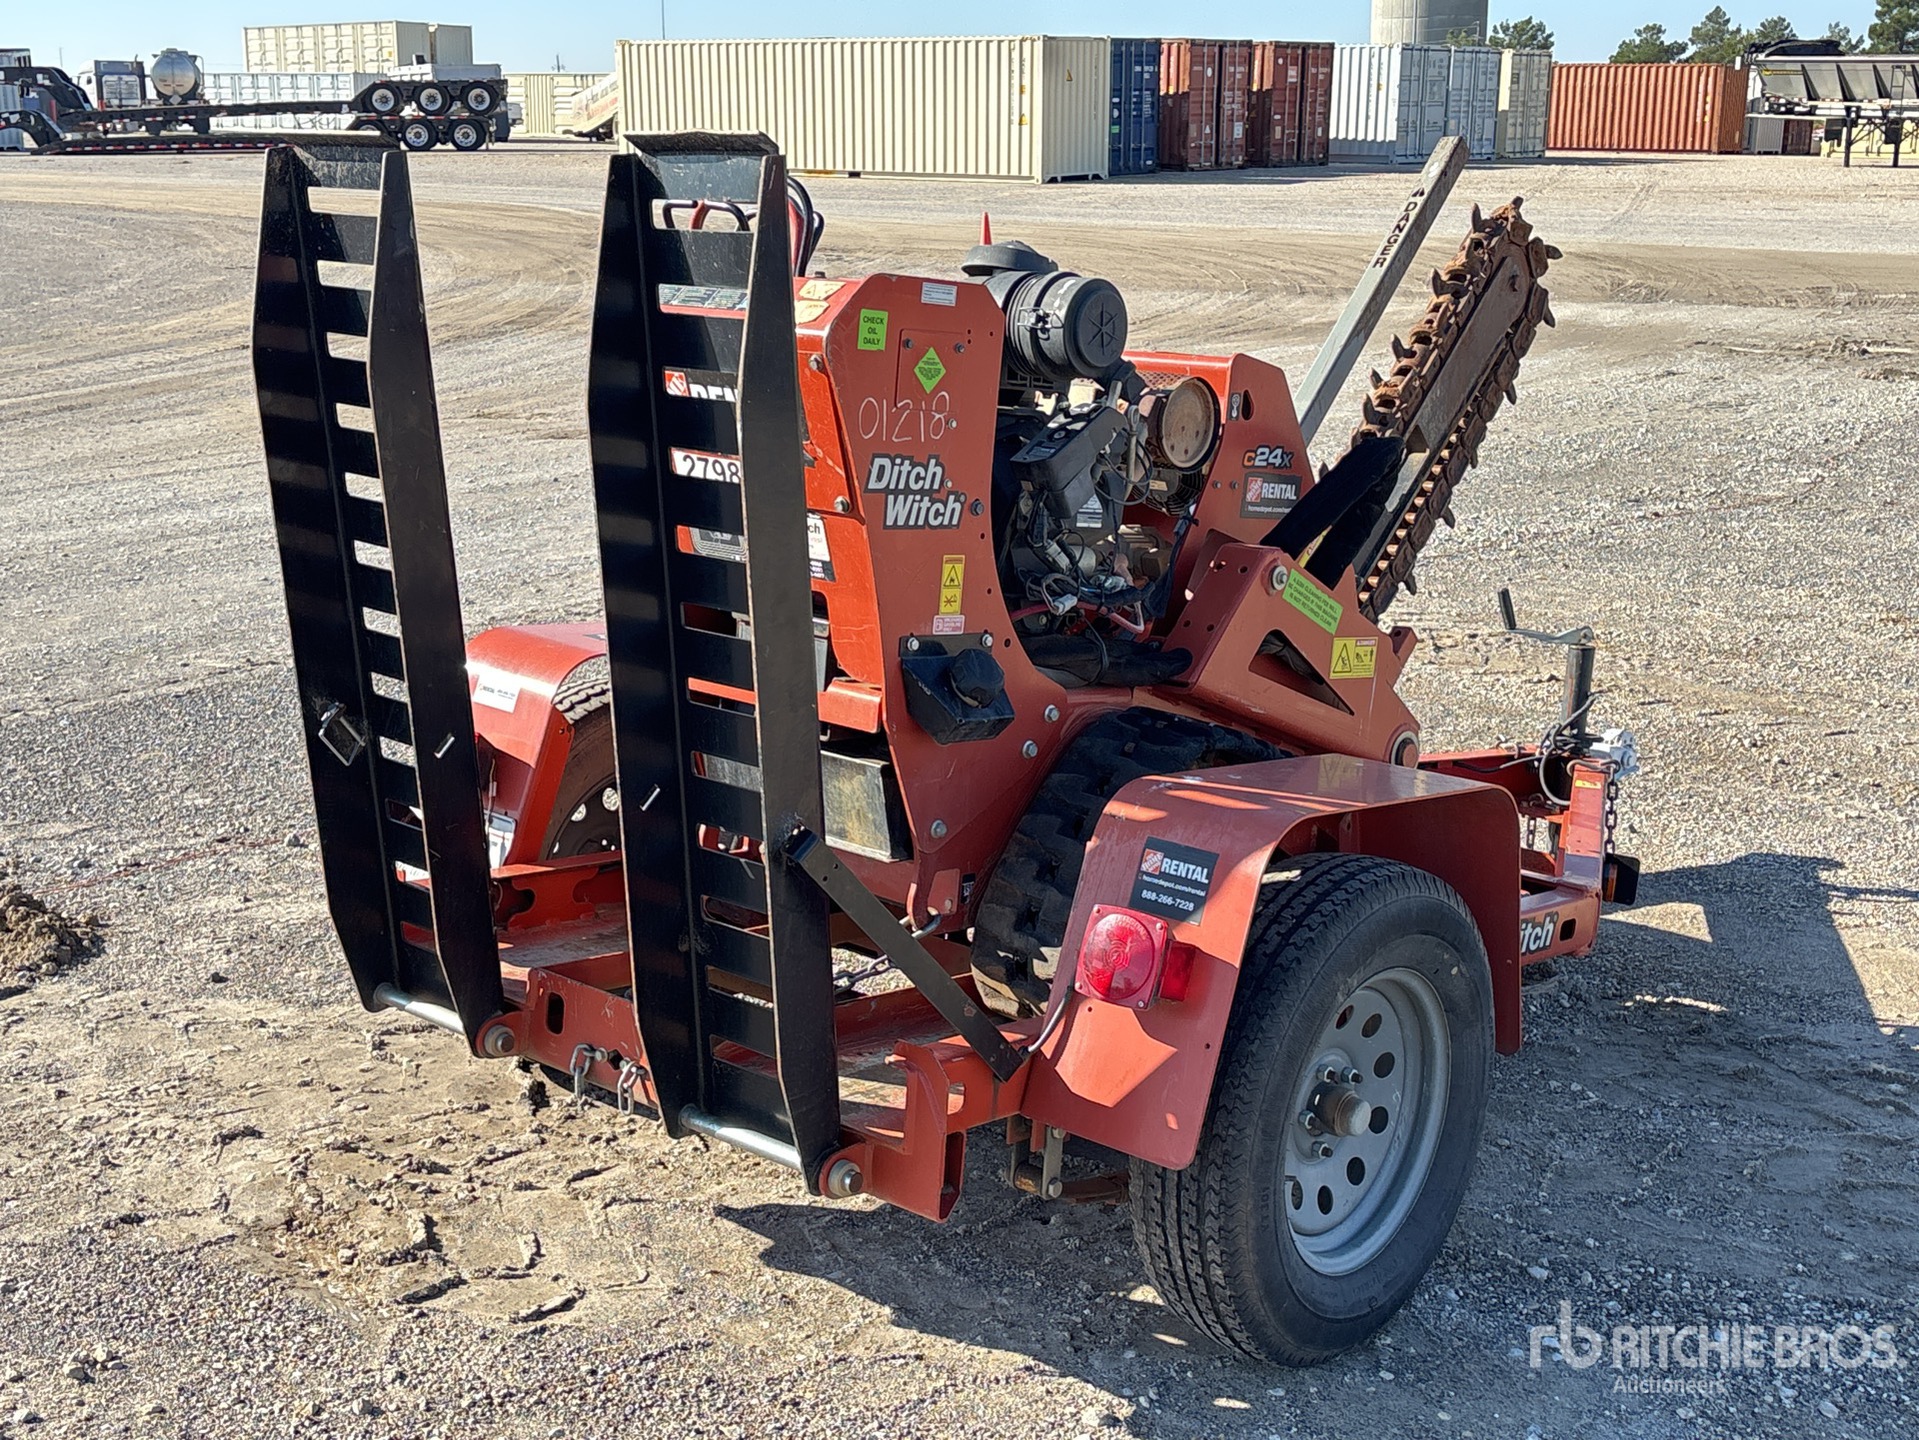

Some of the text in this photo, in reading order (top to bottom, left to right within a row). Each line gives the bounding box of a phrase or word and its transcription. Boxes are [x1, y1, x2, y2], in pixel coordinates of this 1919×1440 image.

[1372, 201, 1418, 269] DANGER
[862, 315, 885, 325] CHECK
[867, 326, 878, 335] OIL
[863, 336, 881, 346] DAILY
[858, 391, 950, 443] 01218
[867, 457, 943, 491] Ditch
[1261, 482, 1297, 500] RENTAL
[885, 493, 963, 527] Witch
[1160, 857, 1209, 884] RENTAL
[1141, 889, 1195, 912] 888-266-7228
[1520, 915, 1555, 953] itch
